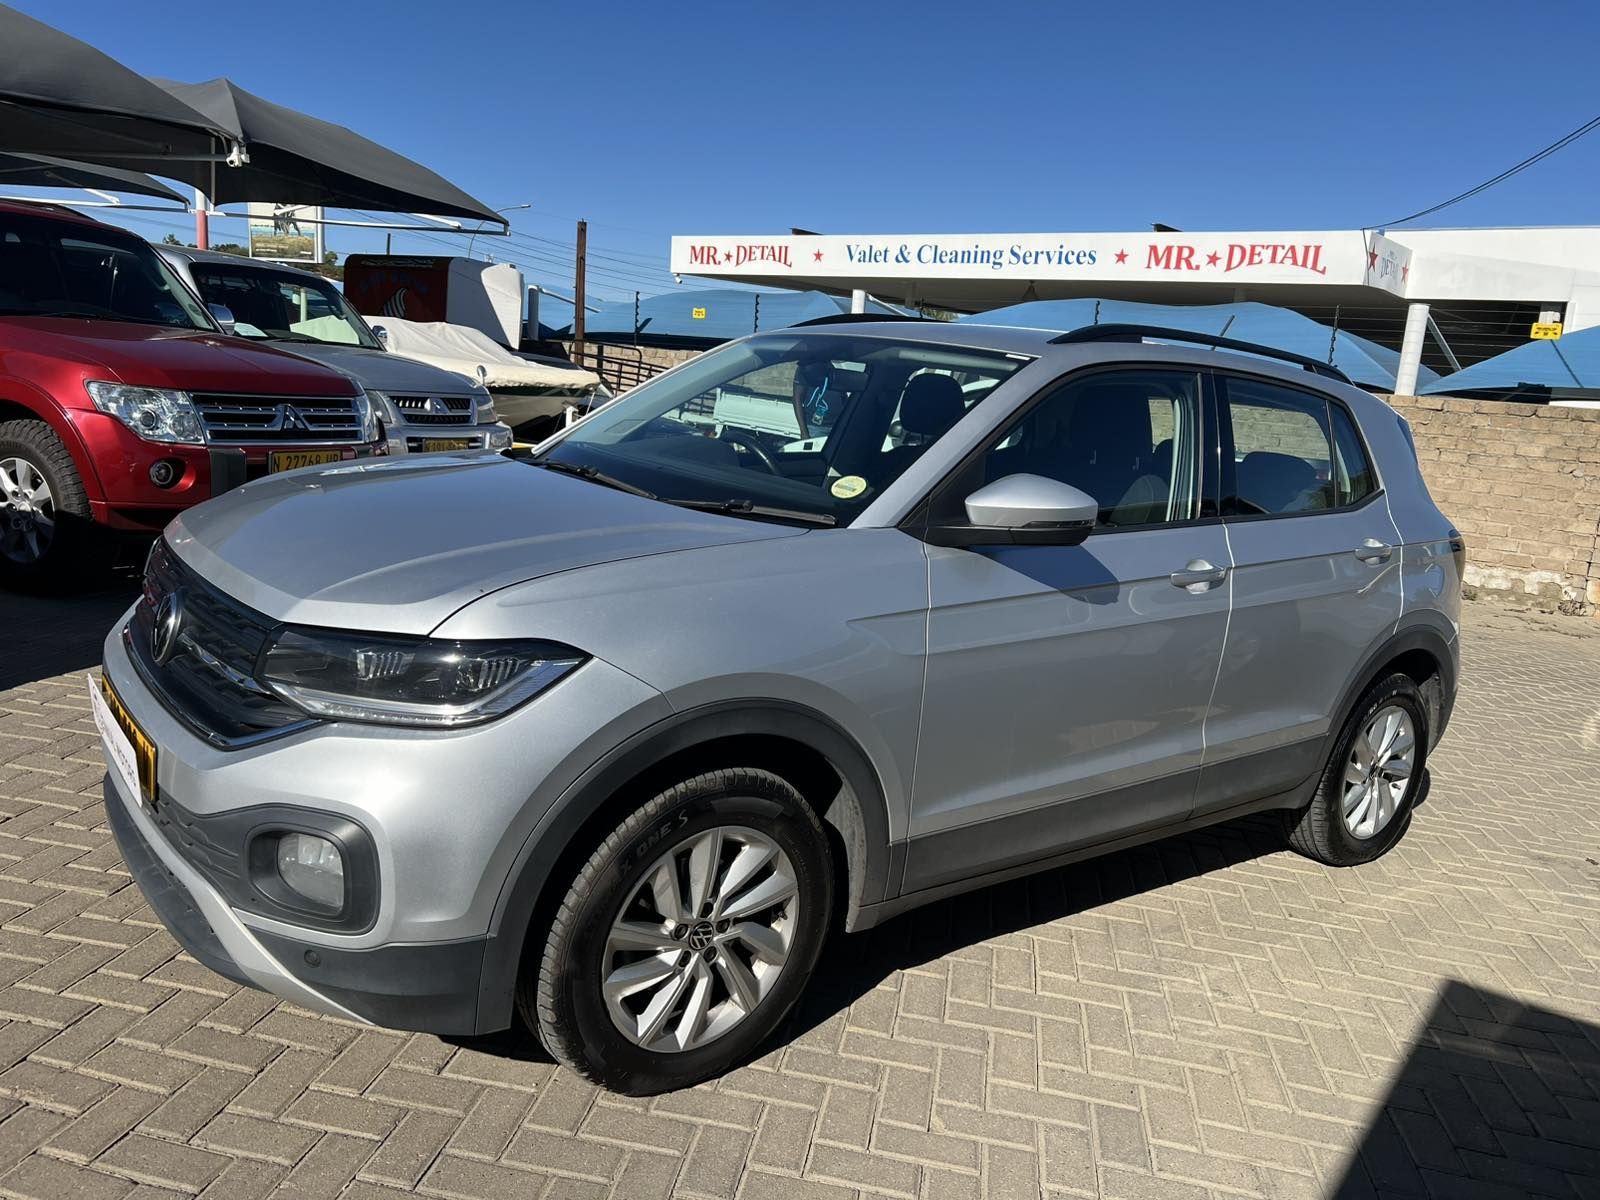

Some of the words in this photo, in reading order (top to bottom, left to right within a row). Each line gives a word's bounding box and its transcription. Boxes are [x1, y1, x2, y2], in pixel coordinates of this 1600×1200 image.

[734, 245, 793, 268] DETAIL
[846, 244, 890, 264] Valet
[895, 244, 911, 264] &
[916, 244, 1004, 269] Cleaning
[1008, 244, 1097, 265] Services
[1224, 244, 1327, 275] DETAIL
[273, 456, 280, 473] N
[637, 821, 671, 856] ONE
[679, 809, 688, 828] S
